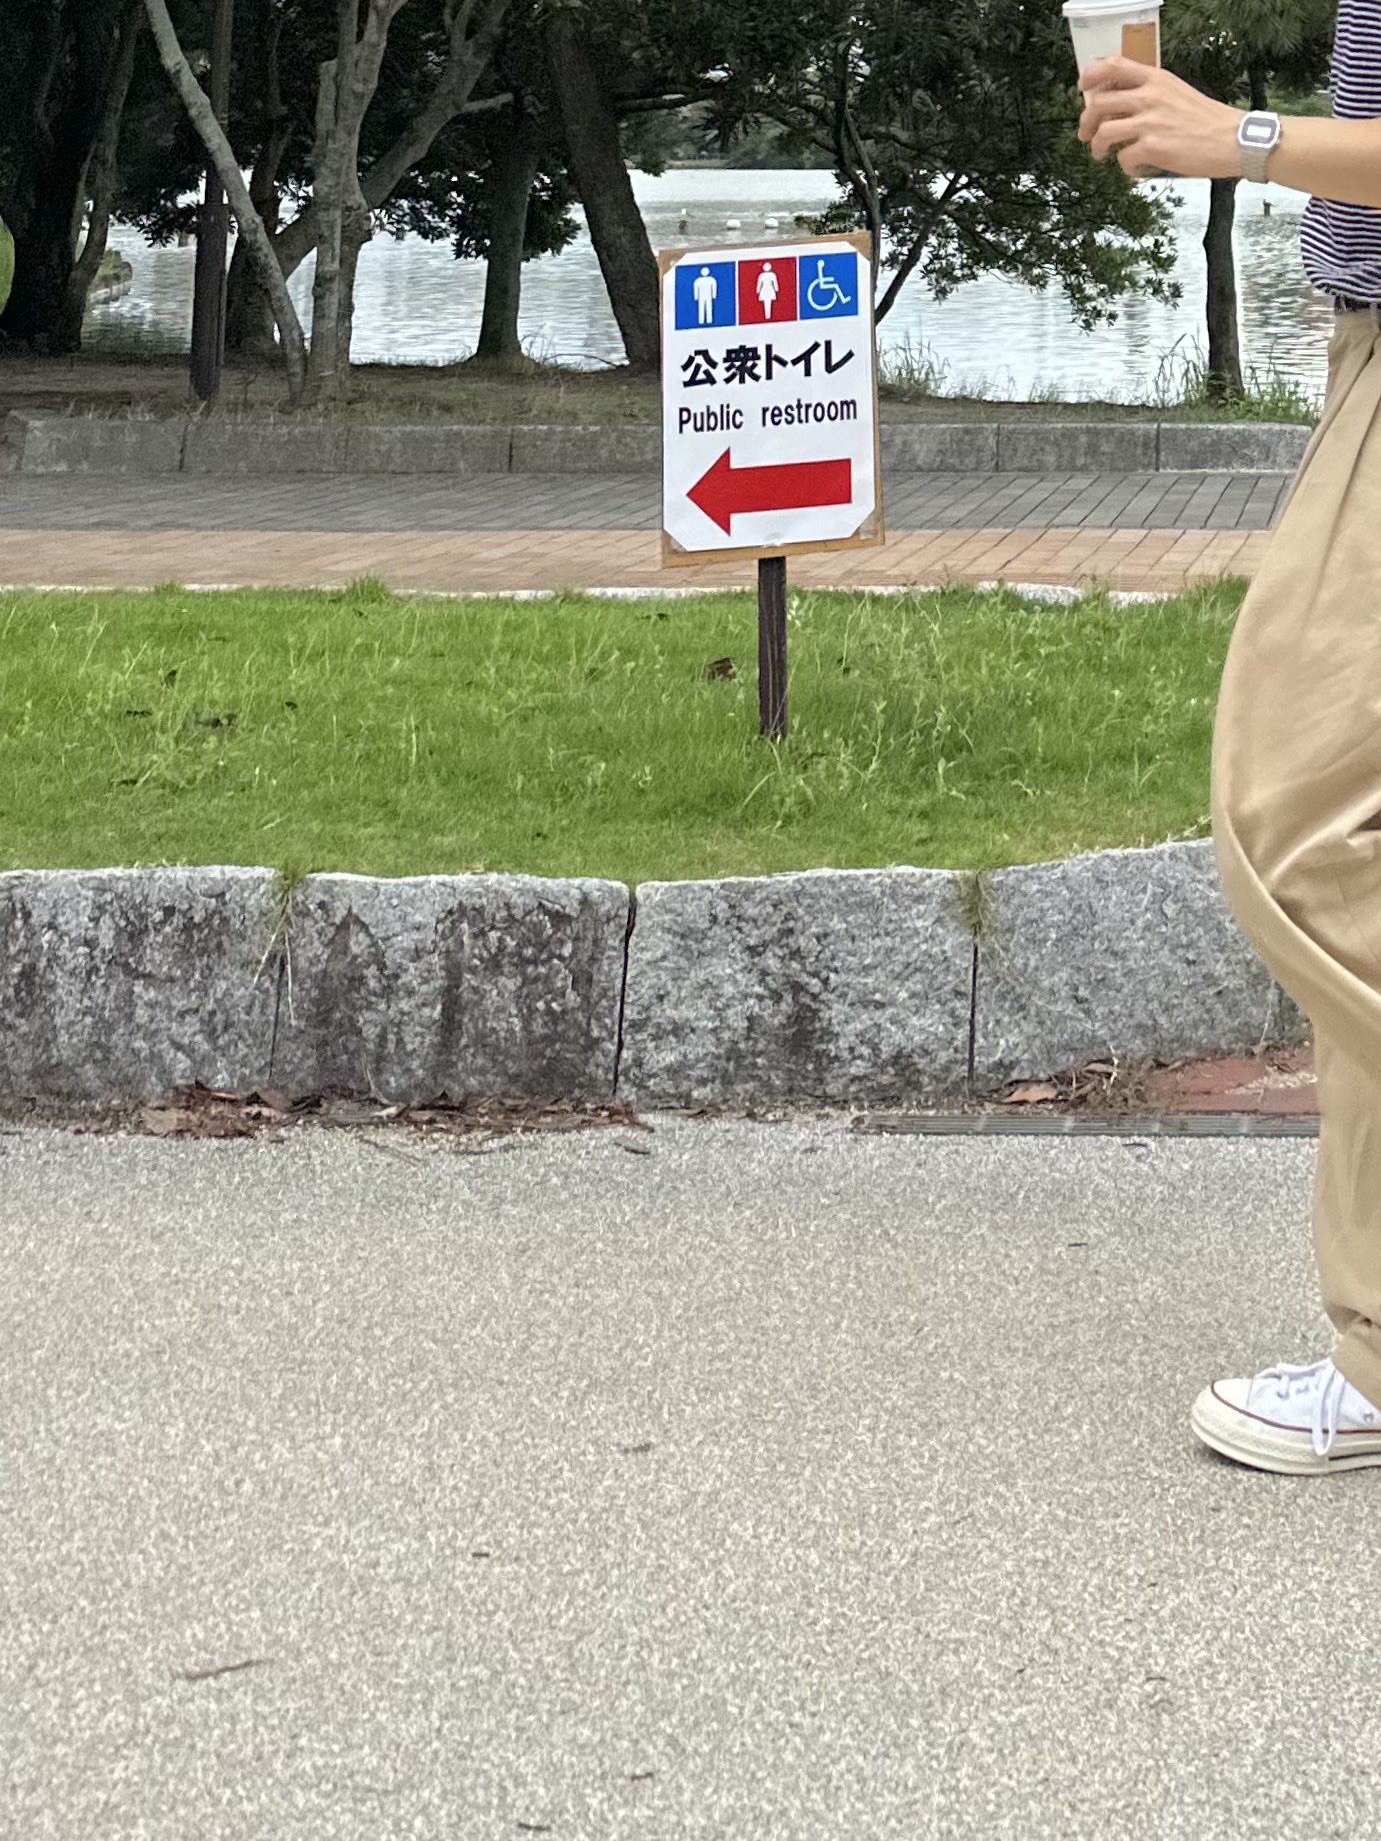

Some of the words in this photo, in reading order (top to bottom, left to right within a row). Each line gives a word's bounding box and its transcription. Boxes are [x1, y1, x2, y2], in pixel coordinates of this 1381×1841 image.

[680, 339, 856, 388] 公衆トイレ
[678, 403, 744, 434] Public
[761, 398, 858, 428] restroom
